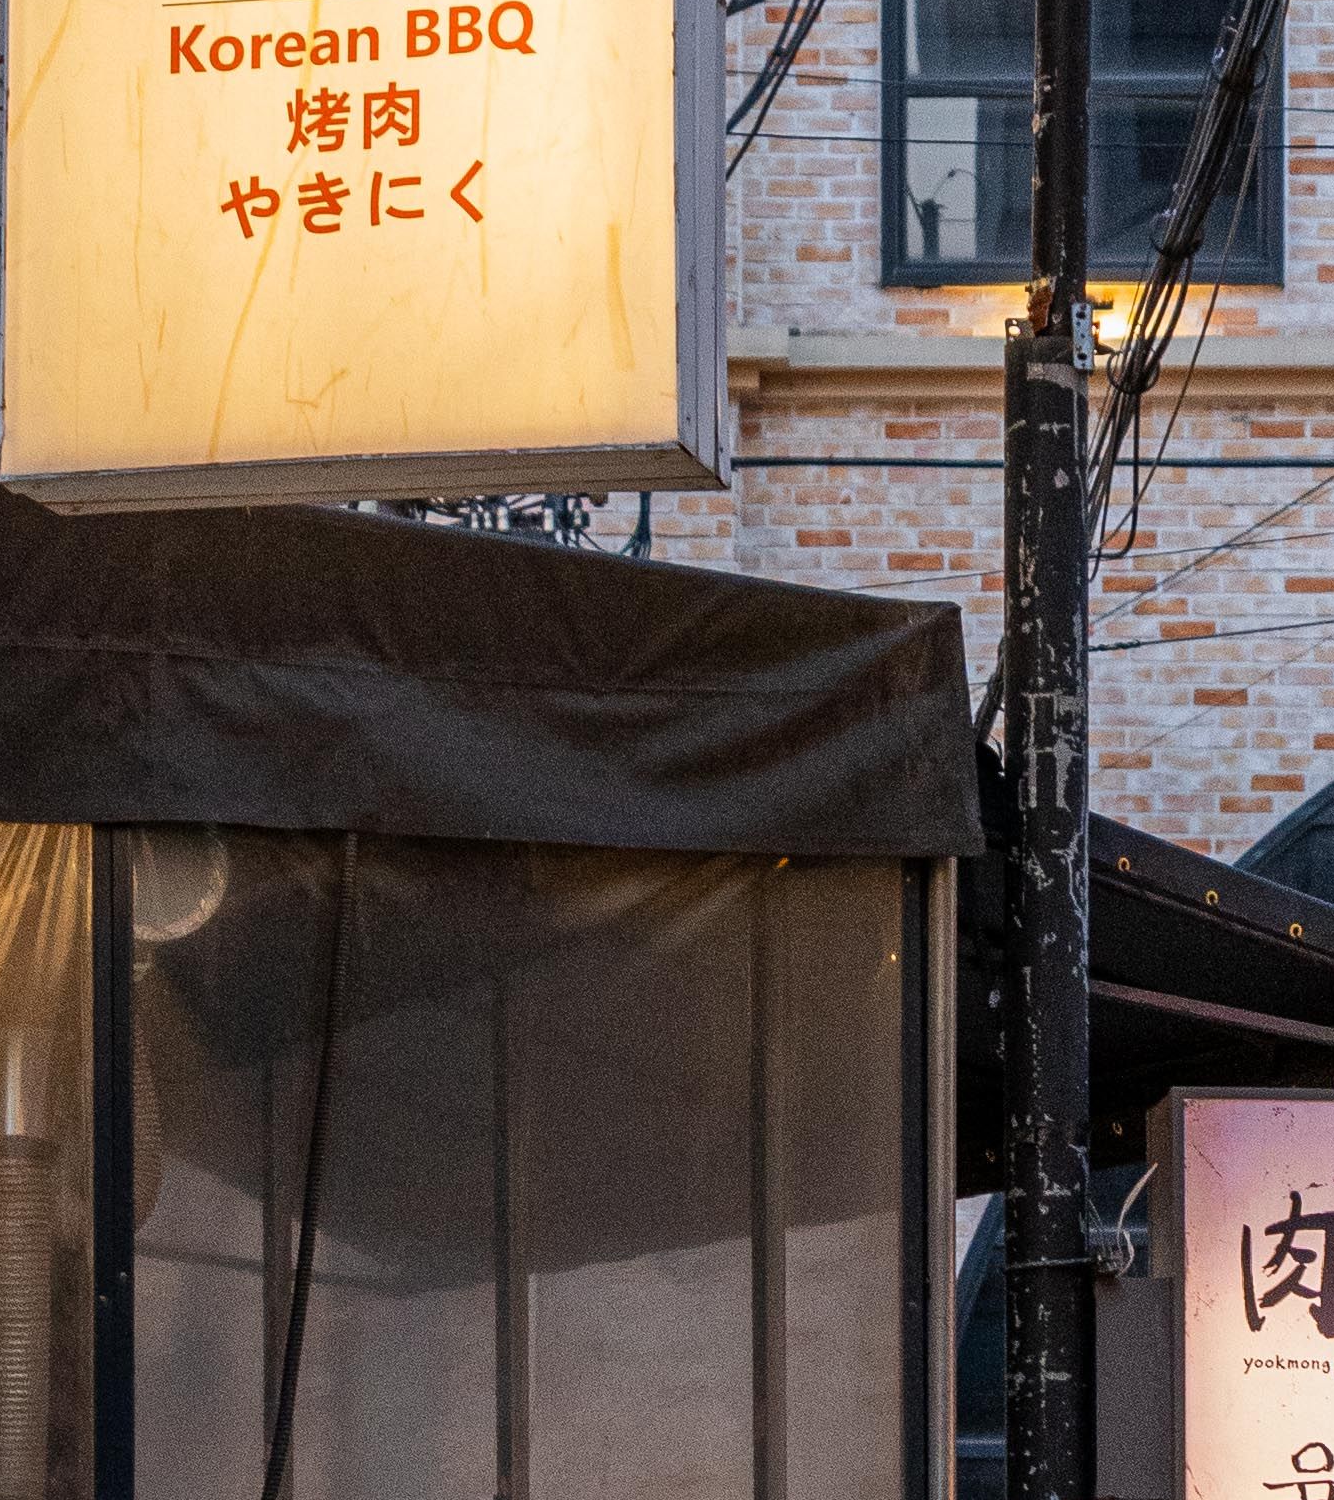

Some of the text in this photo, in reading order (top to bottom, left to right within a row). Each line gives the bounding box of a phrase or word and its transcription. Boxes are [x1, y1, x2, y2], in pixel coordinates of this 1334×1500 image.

[169, 0, 537, 74] Korean BBQ
[287, 81, 421, 154] 烤肉
[221, 159, 484, 240] やきにく
[1242, 1354, 1331, 1375] yookmong
